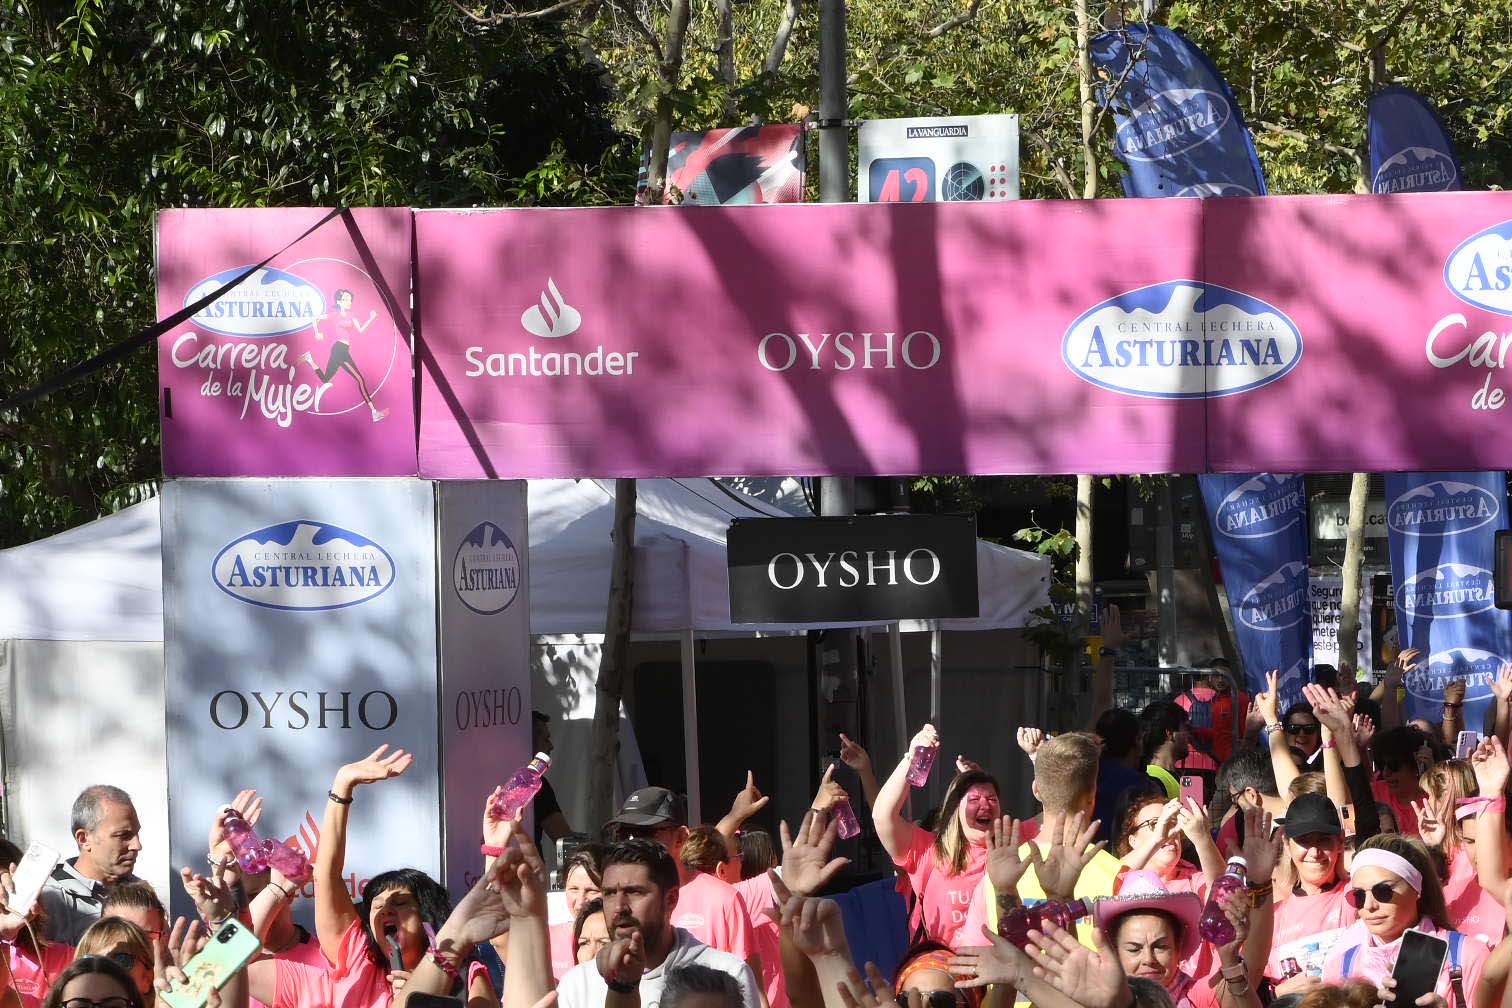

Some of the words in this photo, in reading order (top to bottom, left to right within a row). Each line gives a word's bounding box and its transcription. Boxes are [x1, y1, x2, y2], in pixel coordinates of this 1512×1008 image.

[1118, 322, 1193, 332] CENTRAL
[1201, 321, 1275, 332] LECHERA
[172, 332, 288, 370] Carrera
[465, 345, 639, 377] Santander
[758, 332, 941, 371] OYSHO
[1081, 325, 1284, 368] ASTURIANA
[201, 371, 221, 396] de
[227, 371, 242, 396] la
[240, 367, 333, 428] Mujer
[1471, 372, 1506, 411] de
[227, 554, 382, 588] ASTURIANA
[254, 552, 313, 561] CENTRAL
[458, 556, 516, 591] ASTURIANA
[768, 548, 941, 590] OYSHO
[209, 690, 398, 730] OYSHO
[455, 686, 522, 731] OYSHO
